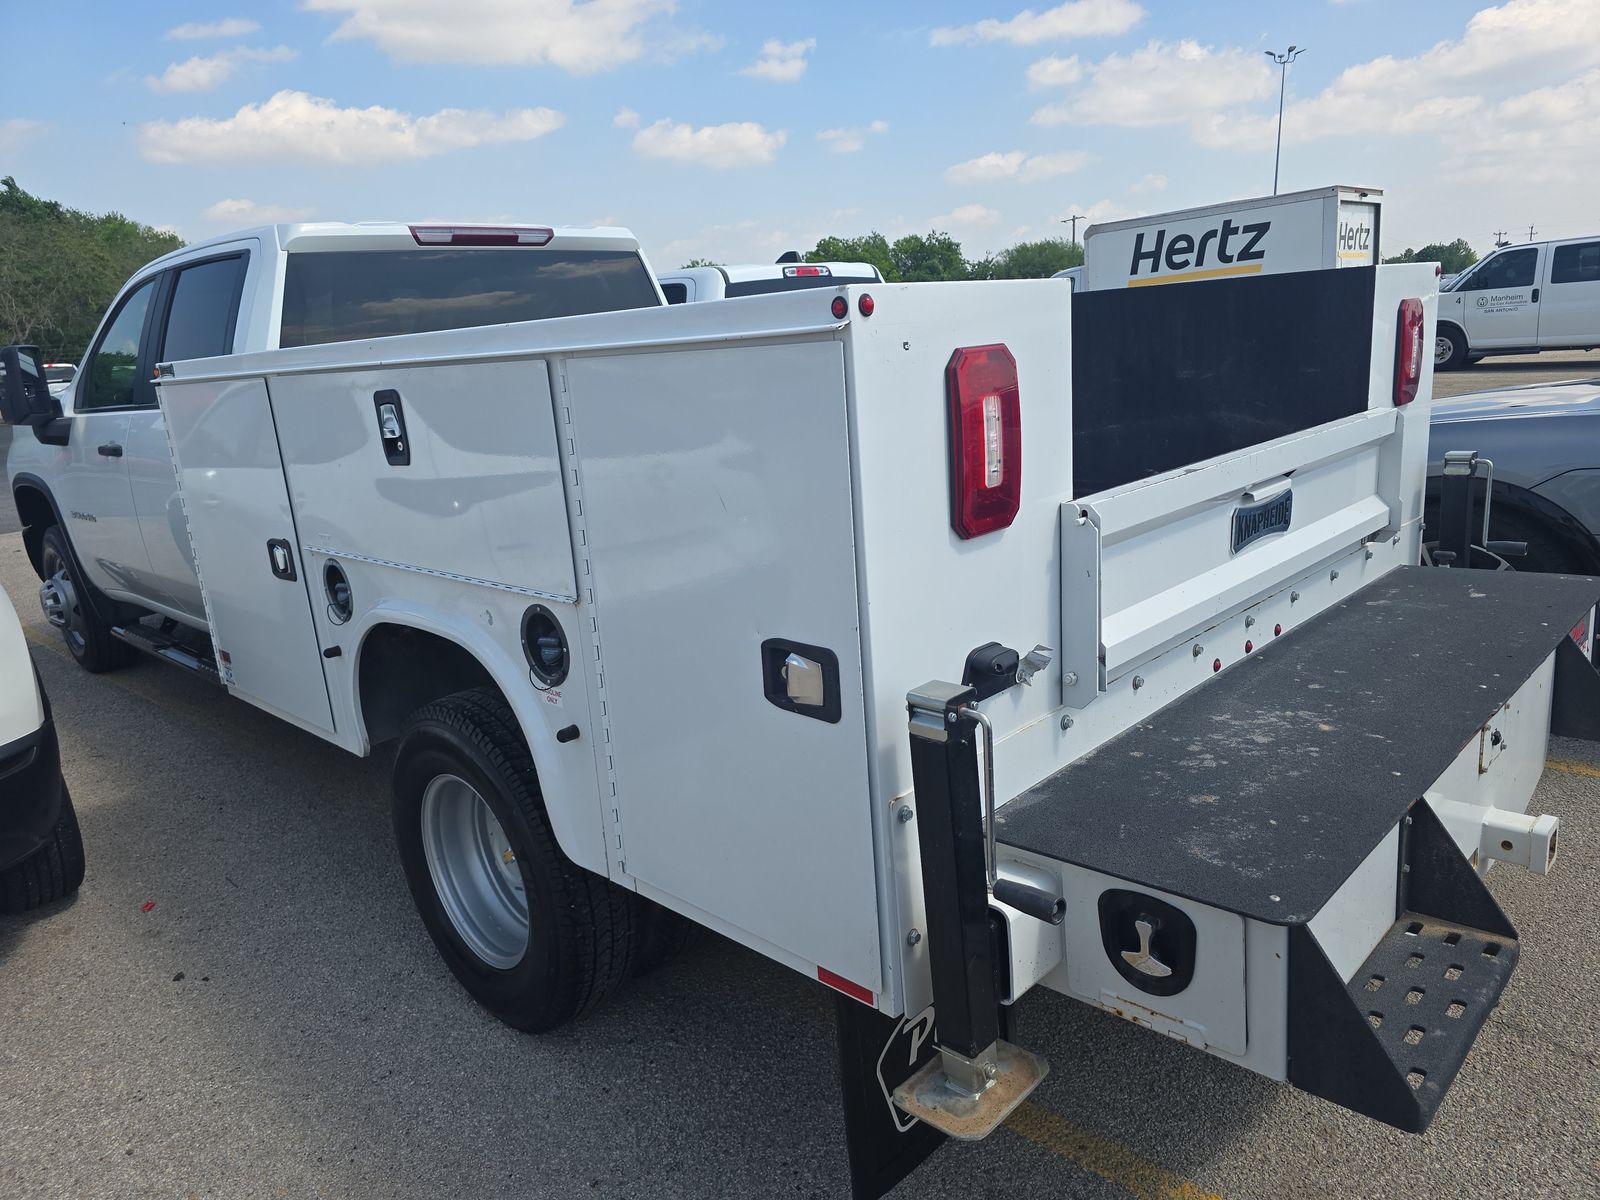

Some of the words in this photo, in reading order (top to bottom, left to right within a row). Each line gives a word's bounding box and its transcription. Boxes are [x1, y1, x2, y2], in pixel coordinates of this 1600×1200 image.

[1130, 219, 1271, 275] Hertz
[1338, 222, 1370, 250] Hertz
[1490, 294, 1523, 302] Manheim
[1235, 496, 1291, 546] KNAPHEIDE
